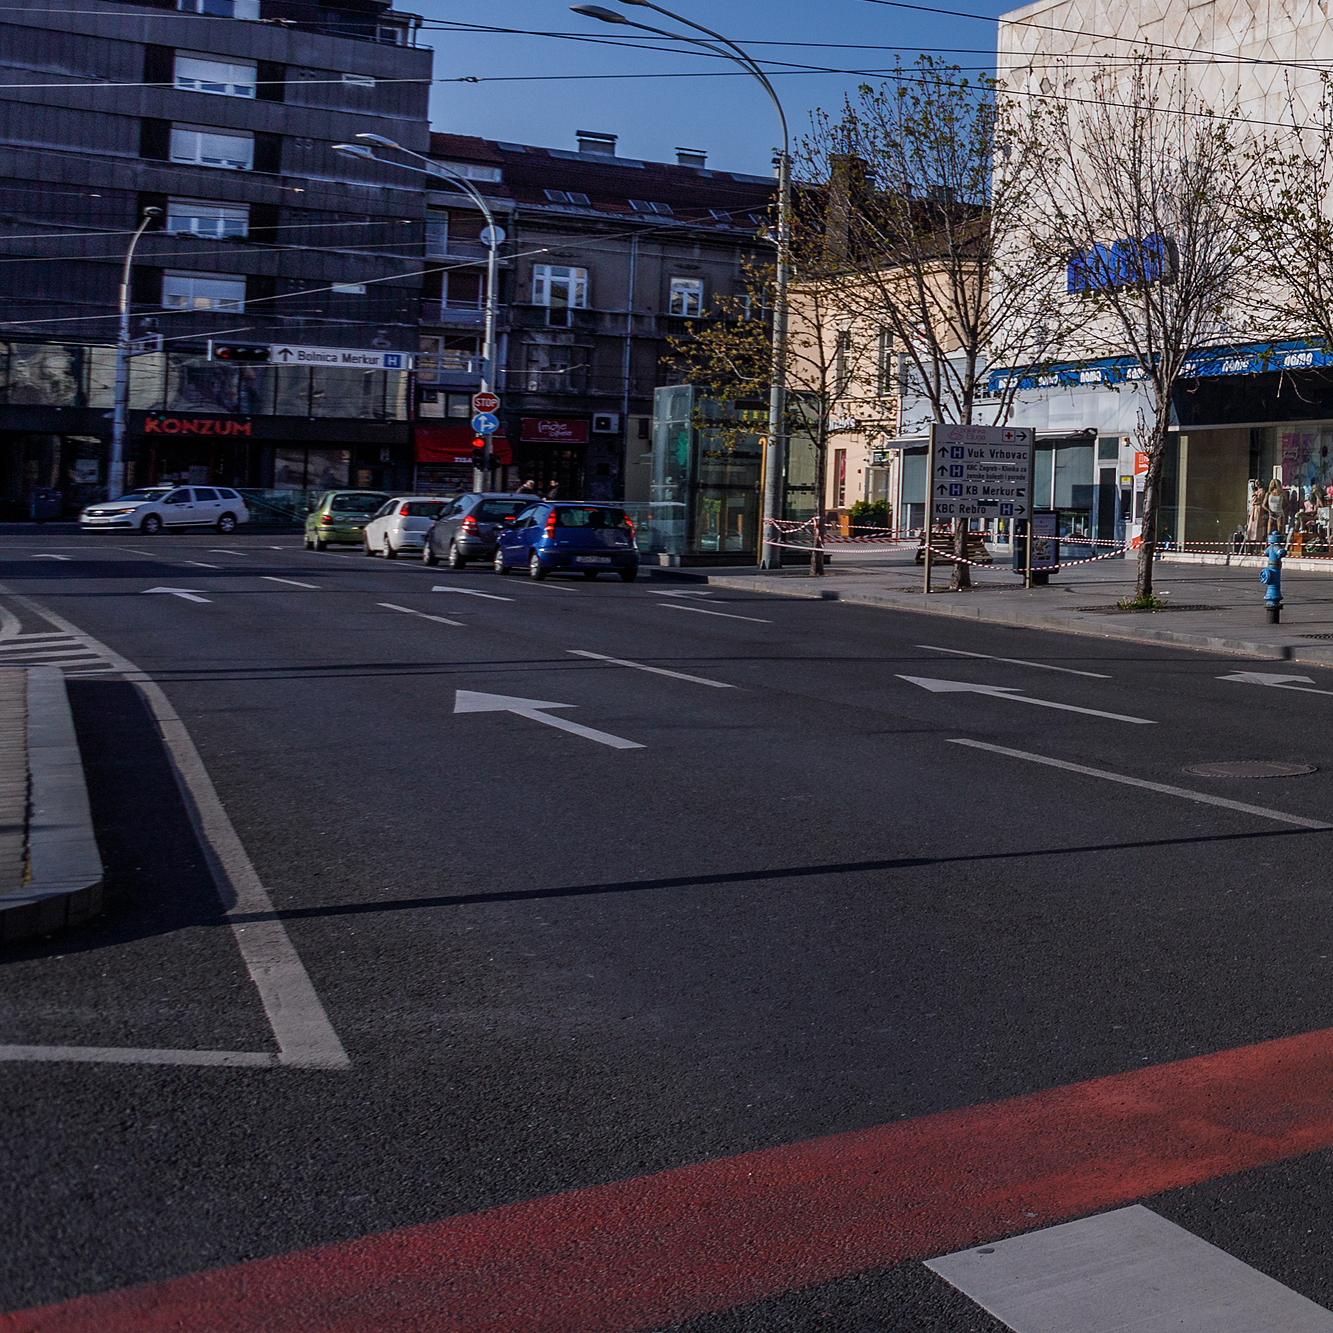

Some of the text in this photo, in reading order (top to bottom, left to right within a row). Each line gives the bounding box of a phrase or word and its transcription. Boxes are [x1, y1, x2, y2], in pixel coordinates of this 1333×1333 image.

[297, 350, 338, 363] Bolnica
[342, 353, 381, 365] Merkur
[1283, 352, 1314, 366] nama
[474, 397, 497, 408] STOP
[144, 417, 252, 436] KONZUM
[967, 448, 985, 458] Vuk
[989, 449, 1028, 459] Vrhovac
[966, 486, 978, 495] KB
[982, 486, 1015, 496] Merkur
[935, 503, 955, 514] KBC
[959, 504, 987, 514] Rebro
